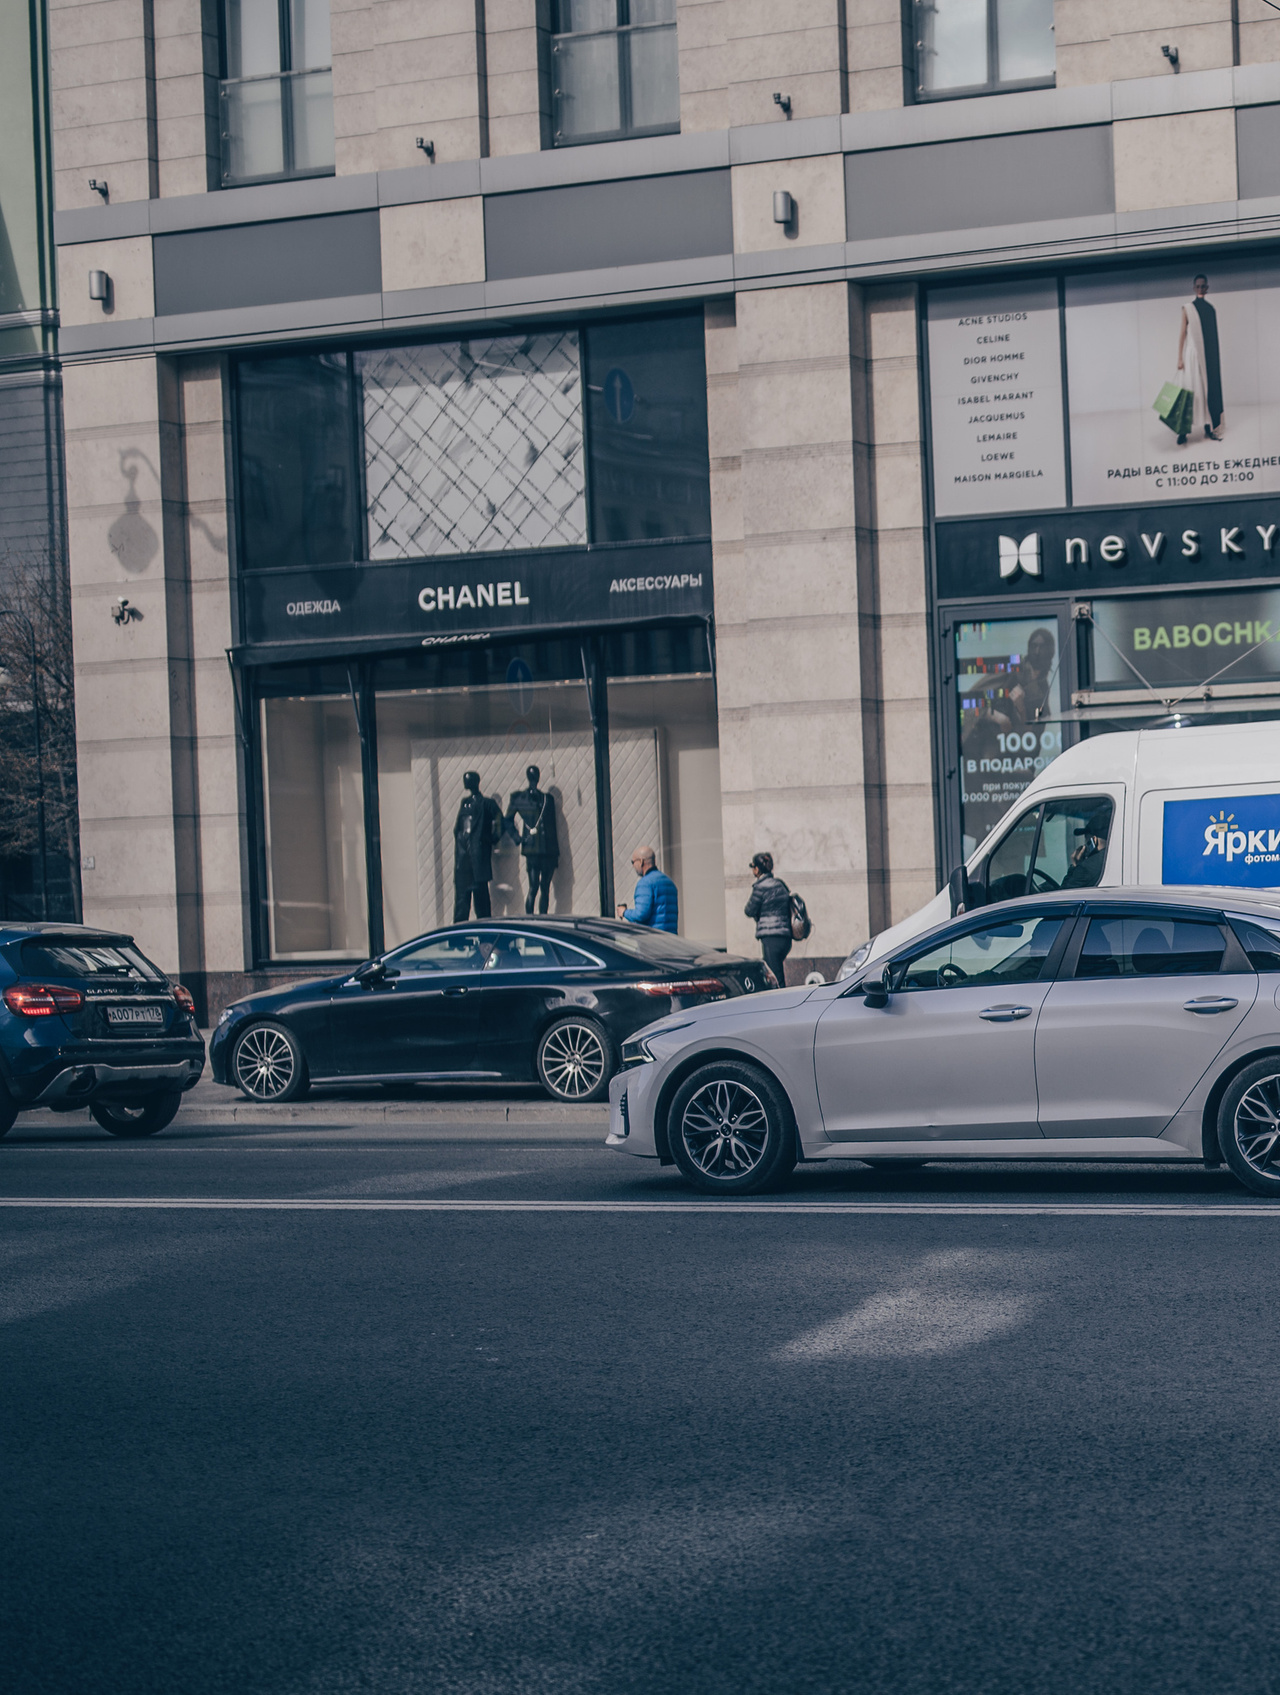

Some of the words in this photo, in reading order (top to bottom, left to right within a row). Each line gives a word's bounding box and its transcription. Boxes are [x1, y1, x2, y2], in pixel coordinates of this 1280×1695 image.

[958, 316, 984, 326] ACNE
[986, 312, 1028, 324] STUDIOS
[976, 334, 1010, 344] CELINE
[963, 356, 987, 365] DIOR
[990, 352, 1025, 362] HOMME
[970, 372, 1019, 384] GIVENCHY
[957, 395, 991, 405] ISABEL
[993, 391, 1034, 401] MARANT
[968, 411, 1025, 424] JACQUEMUS
[976, 432, 1018, 443] LEMAIRE
[981, 452, 1015, 462] LOEWE
[954, 473, 991, 484] MAISON
[994, 469, 1044, 480] MARGIELA
[1107, 468, 1141, 479] РАДЫ
[1145, 465, 1168, 475] ВАС
[1172, 461, 1220, 474] ВИДЕТЬ
[1155, 477, 1163, 488] С
[1167, 475, 1197, 487] 11:00
[1200, 474, 1218, 486] ДО
[1222, 471, 1255, 483] 21:00
[609, 573, 702, 593] АКСЕССУАРЫ
[418, 581, 530, 611] CHANEL
[286, 600, 341, 616] ОДЕЖДА
[996, 731, 1037, 753] 100
[967, 759, 977, 773] В
[991, 791, 1020, 803] рубле
